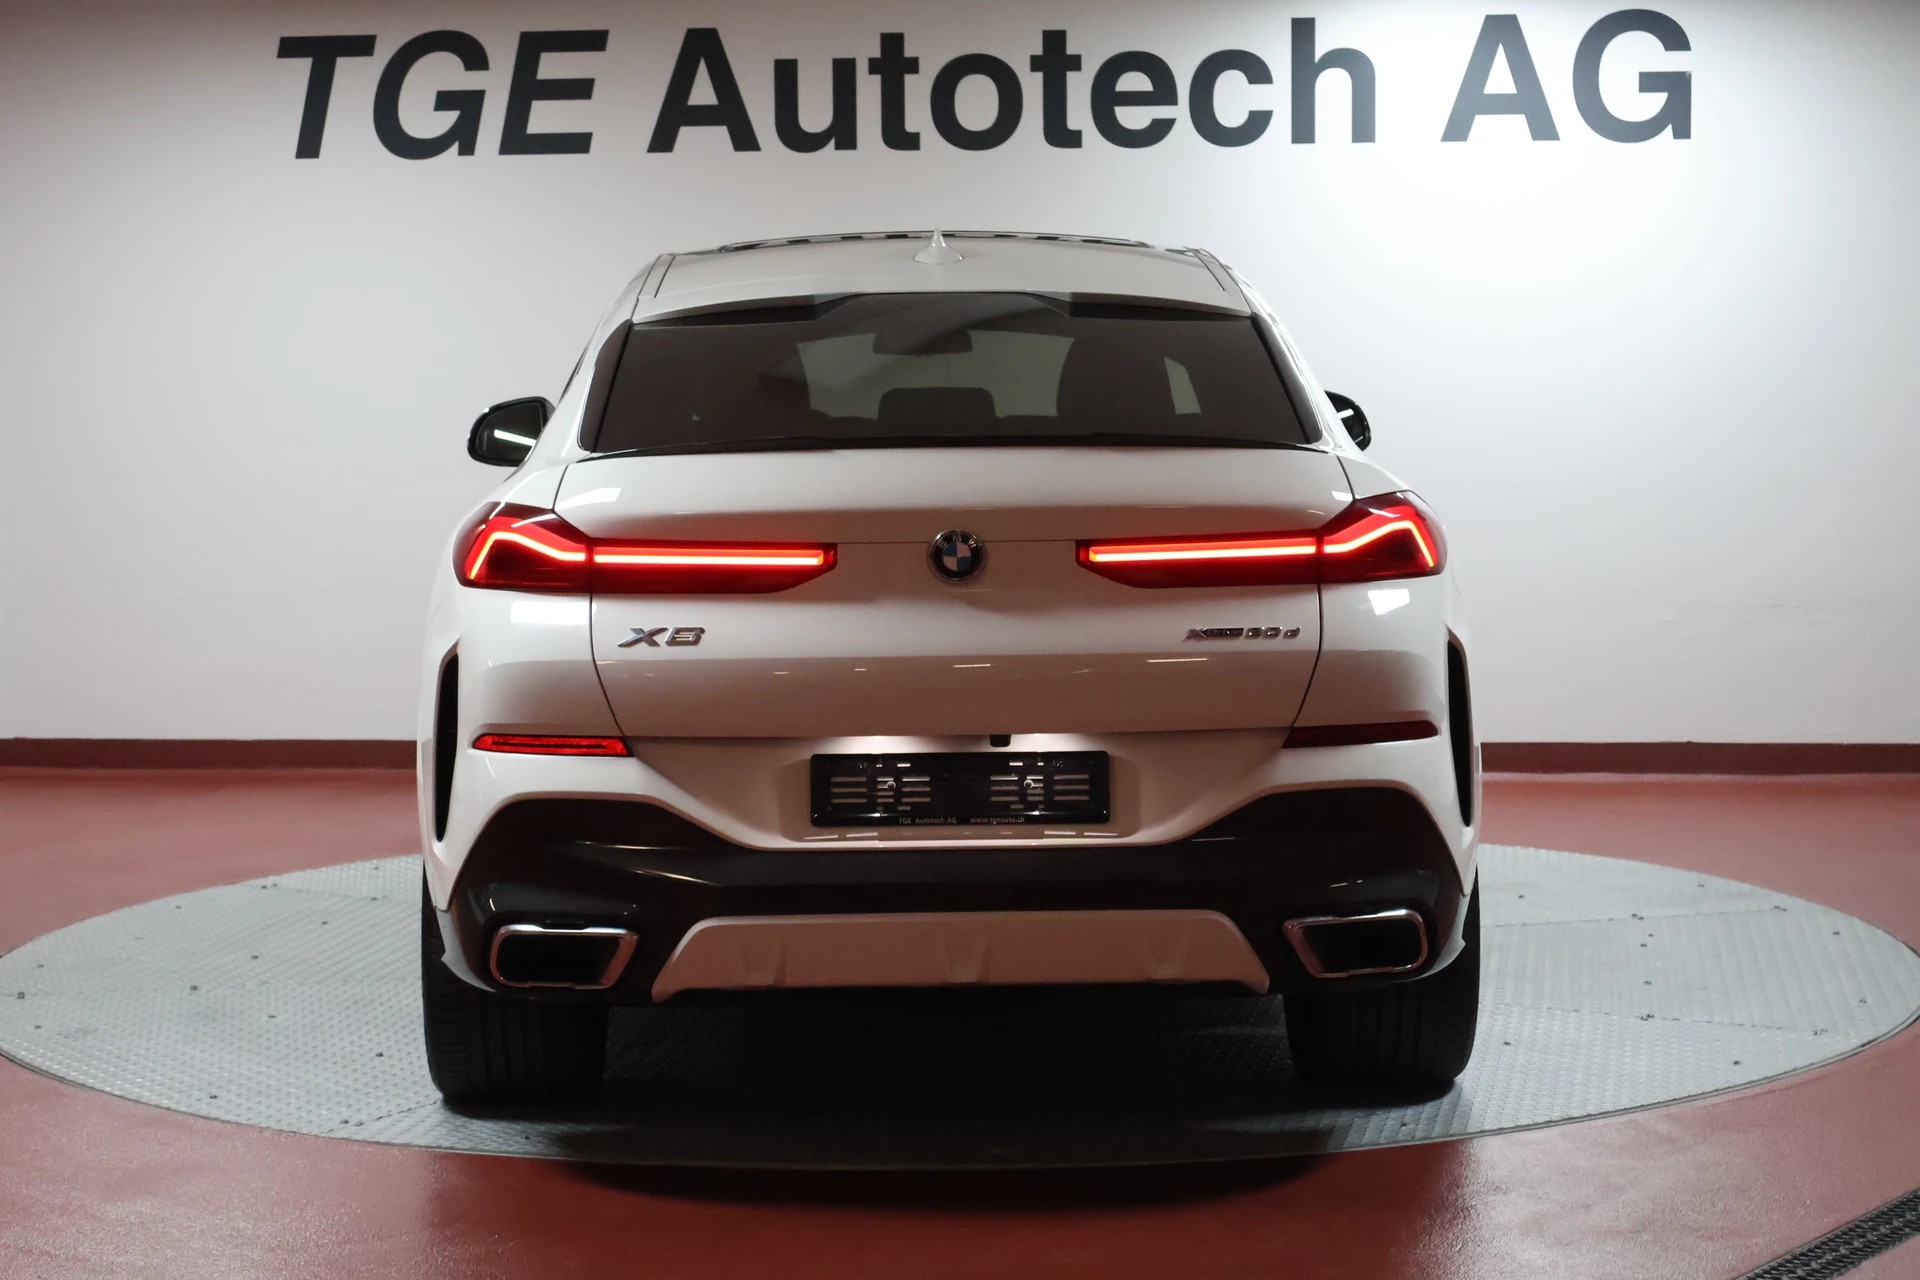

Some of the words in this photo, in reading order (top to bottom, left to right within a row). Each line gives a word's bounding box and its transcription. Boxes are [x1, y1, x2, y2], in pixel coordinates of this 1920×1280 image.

[276, 29, 610, 160] TGE
[647, 18, 1376, 153] Autotech
[1440, 8, 1692, 143] AG
[617, 627, 706, 648] X6
[915, 816, 946, 824] Autotech
